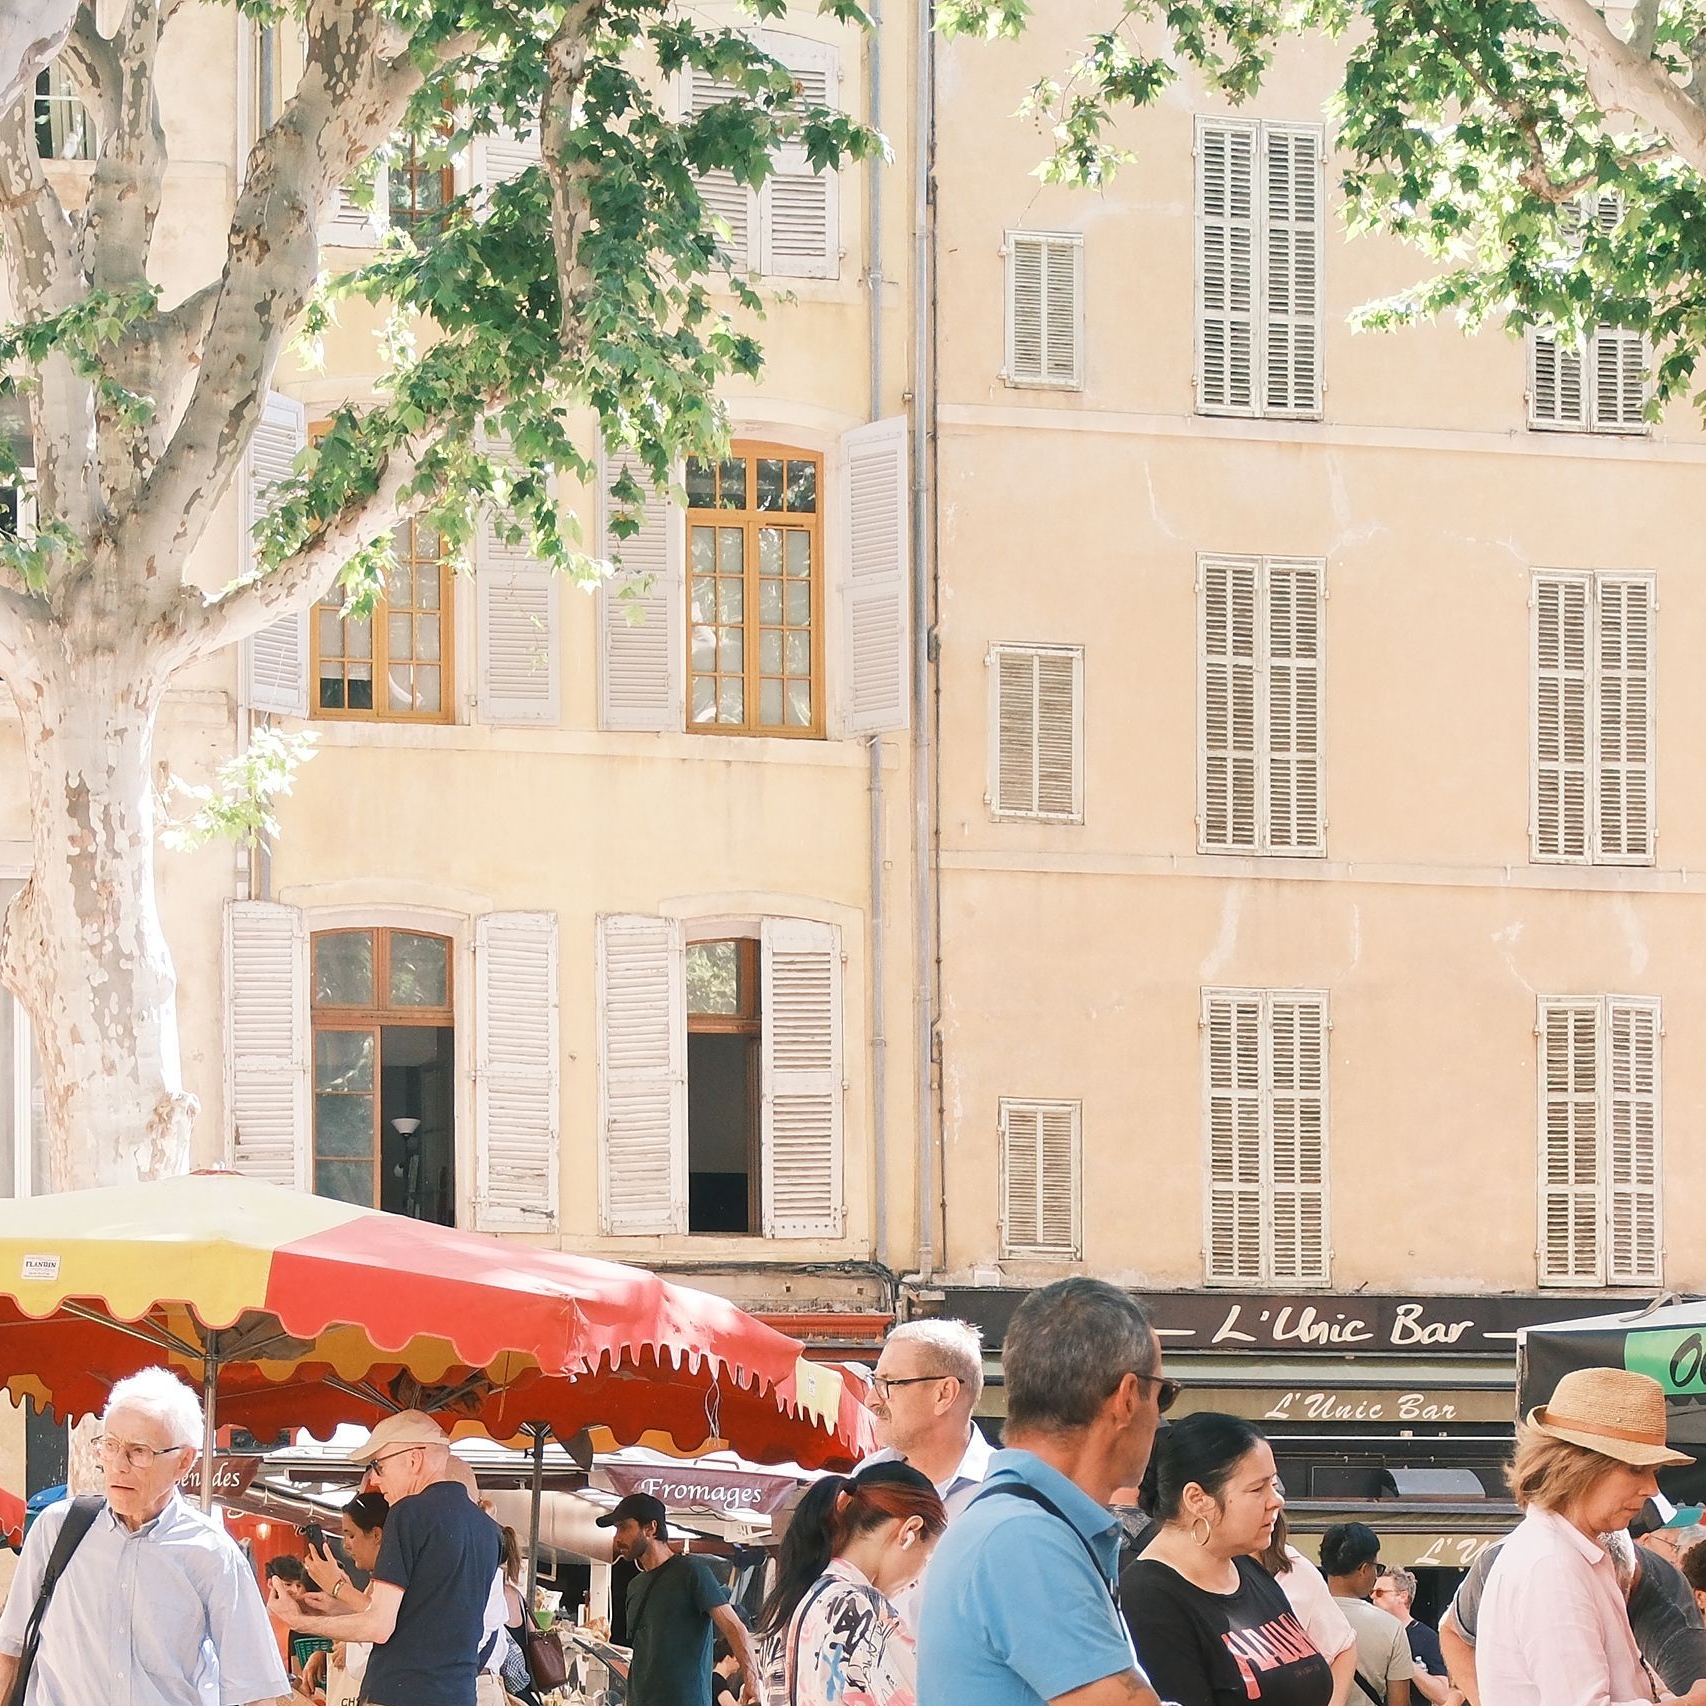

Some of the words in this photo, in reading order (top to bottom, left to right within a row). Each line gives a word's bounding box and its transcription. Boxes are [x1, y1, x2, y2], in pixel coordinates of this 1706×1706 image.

[1211, 1304, 1374, 1344] L'Unic
[1389, 1303, 1474, 1345] Bar
[1264, 1392, 1384, 1419] L'Unic
[1396, 1393, 1458, 1420] Bar
[640, 1477, 762, 1510] Fromages
